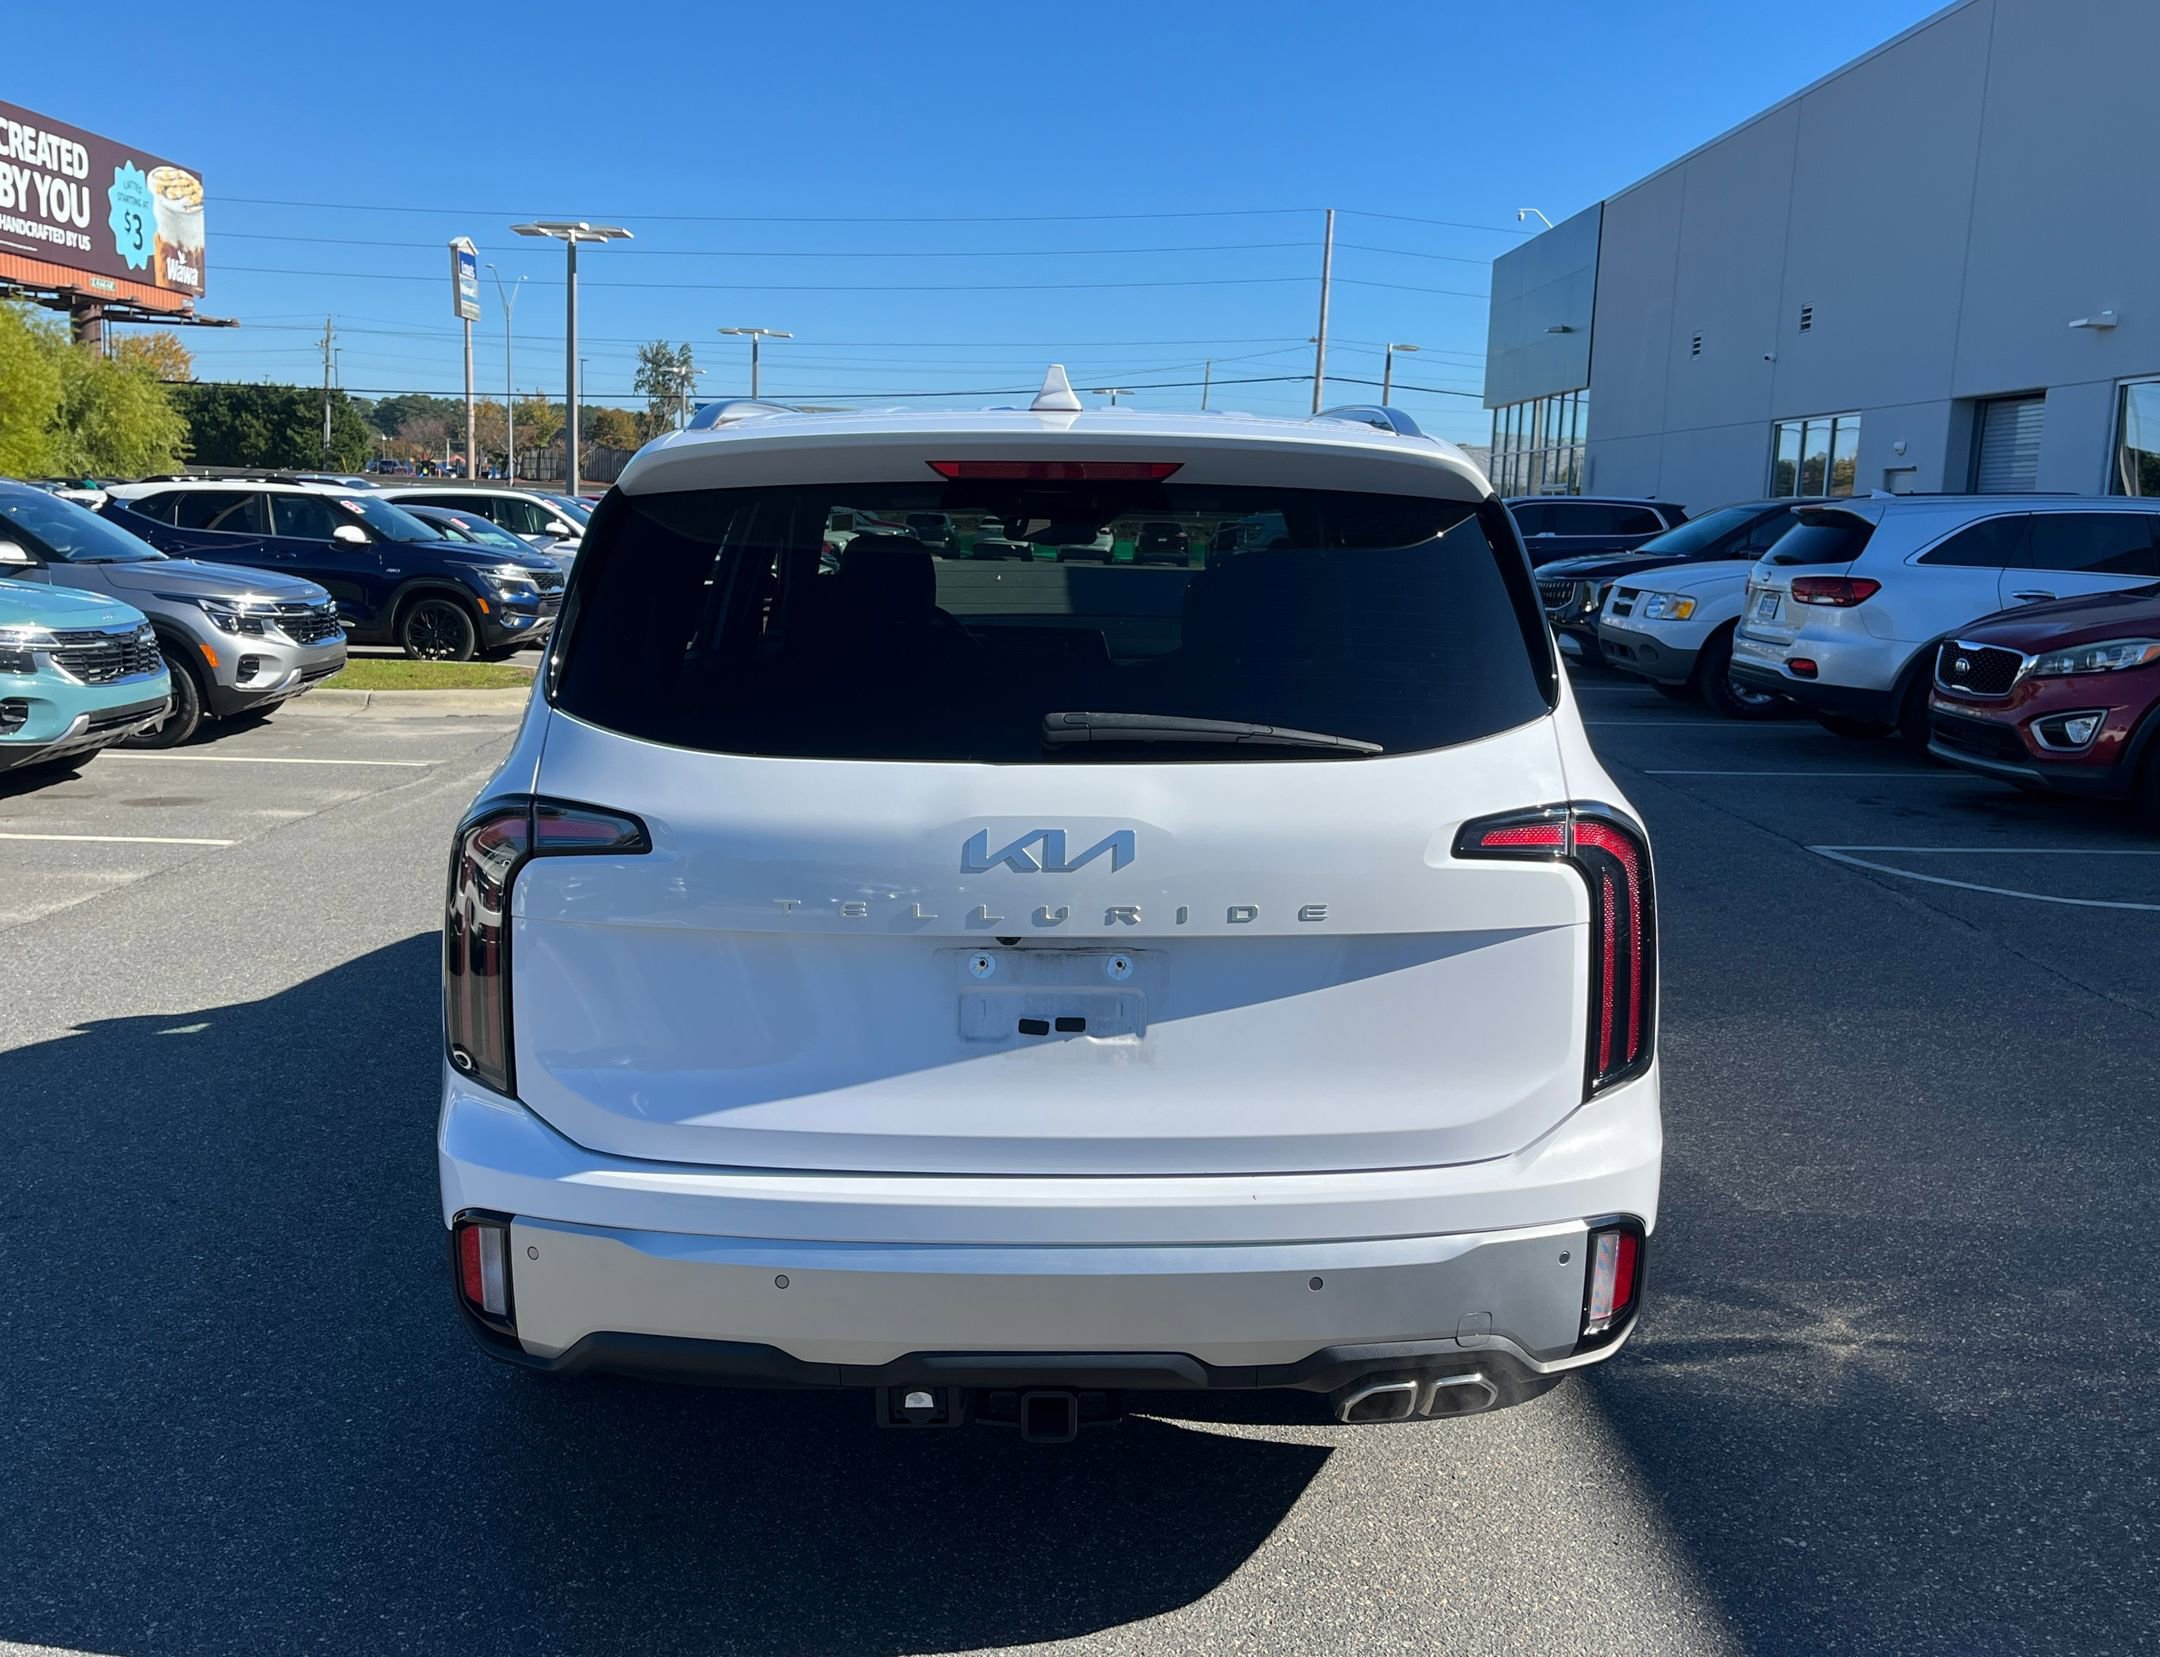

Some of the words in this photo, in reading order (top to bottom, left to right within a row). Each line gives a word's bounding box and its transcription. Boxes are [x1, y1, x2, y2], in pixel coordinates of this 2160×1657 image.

[0, 116, 89, 179] CREATED
[0, 161, 31, 213] BY
[32, 171, 90, 229] YOU
[65, 230, 78, 248] BY
[78, 234, 91, 251] US
[124, 210, 143, 250] $3
[167, 256, 198, 286] Wawa
[960, 827, 1136, 874] KIA
[773, 899, 1329, 926] TELLURIDE
